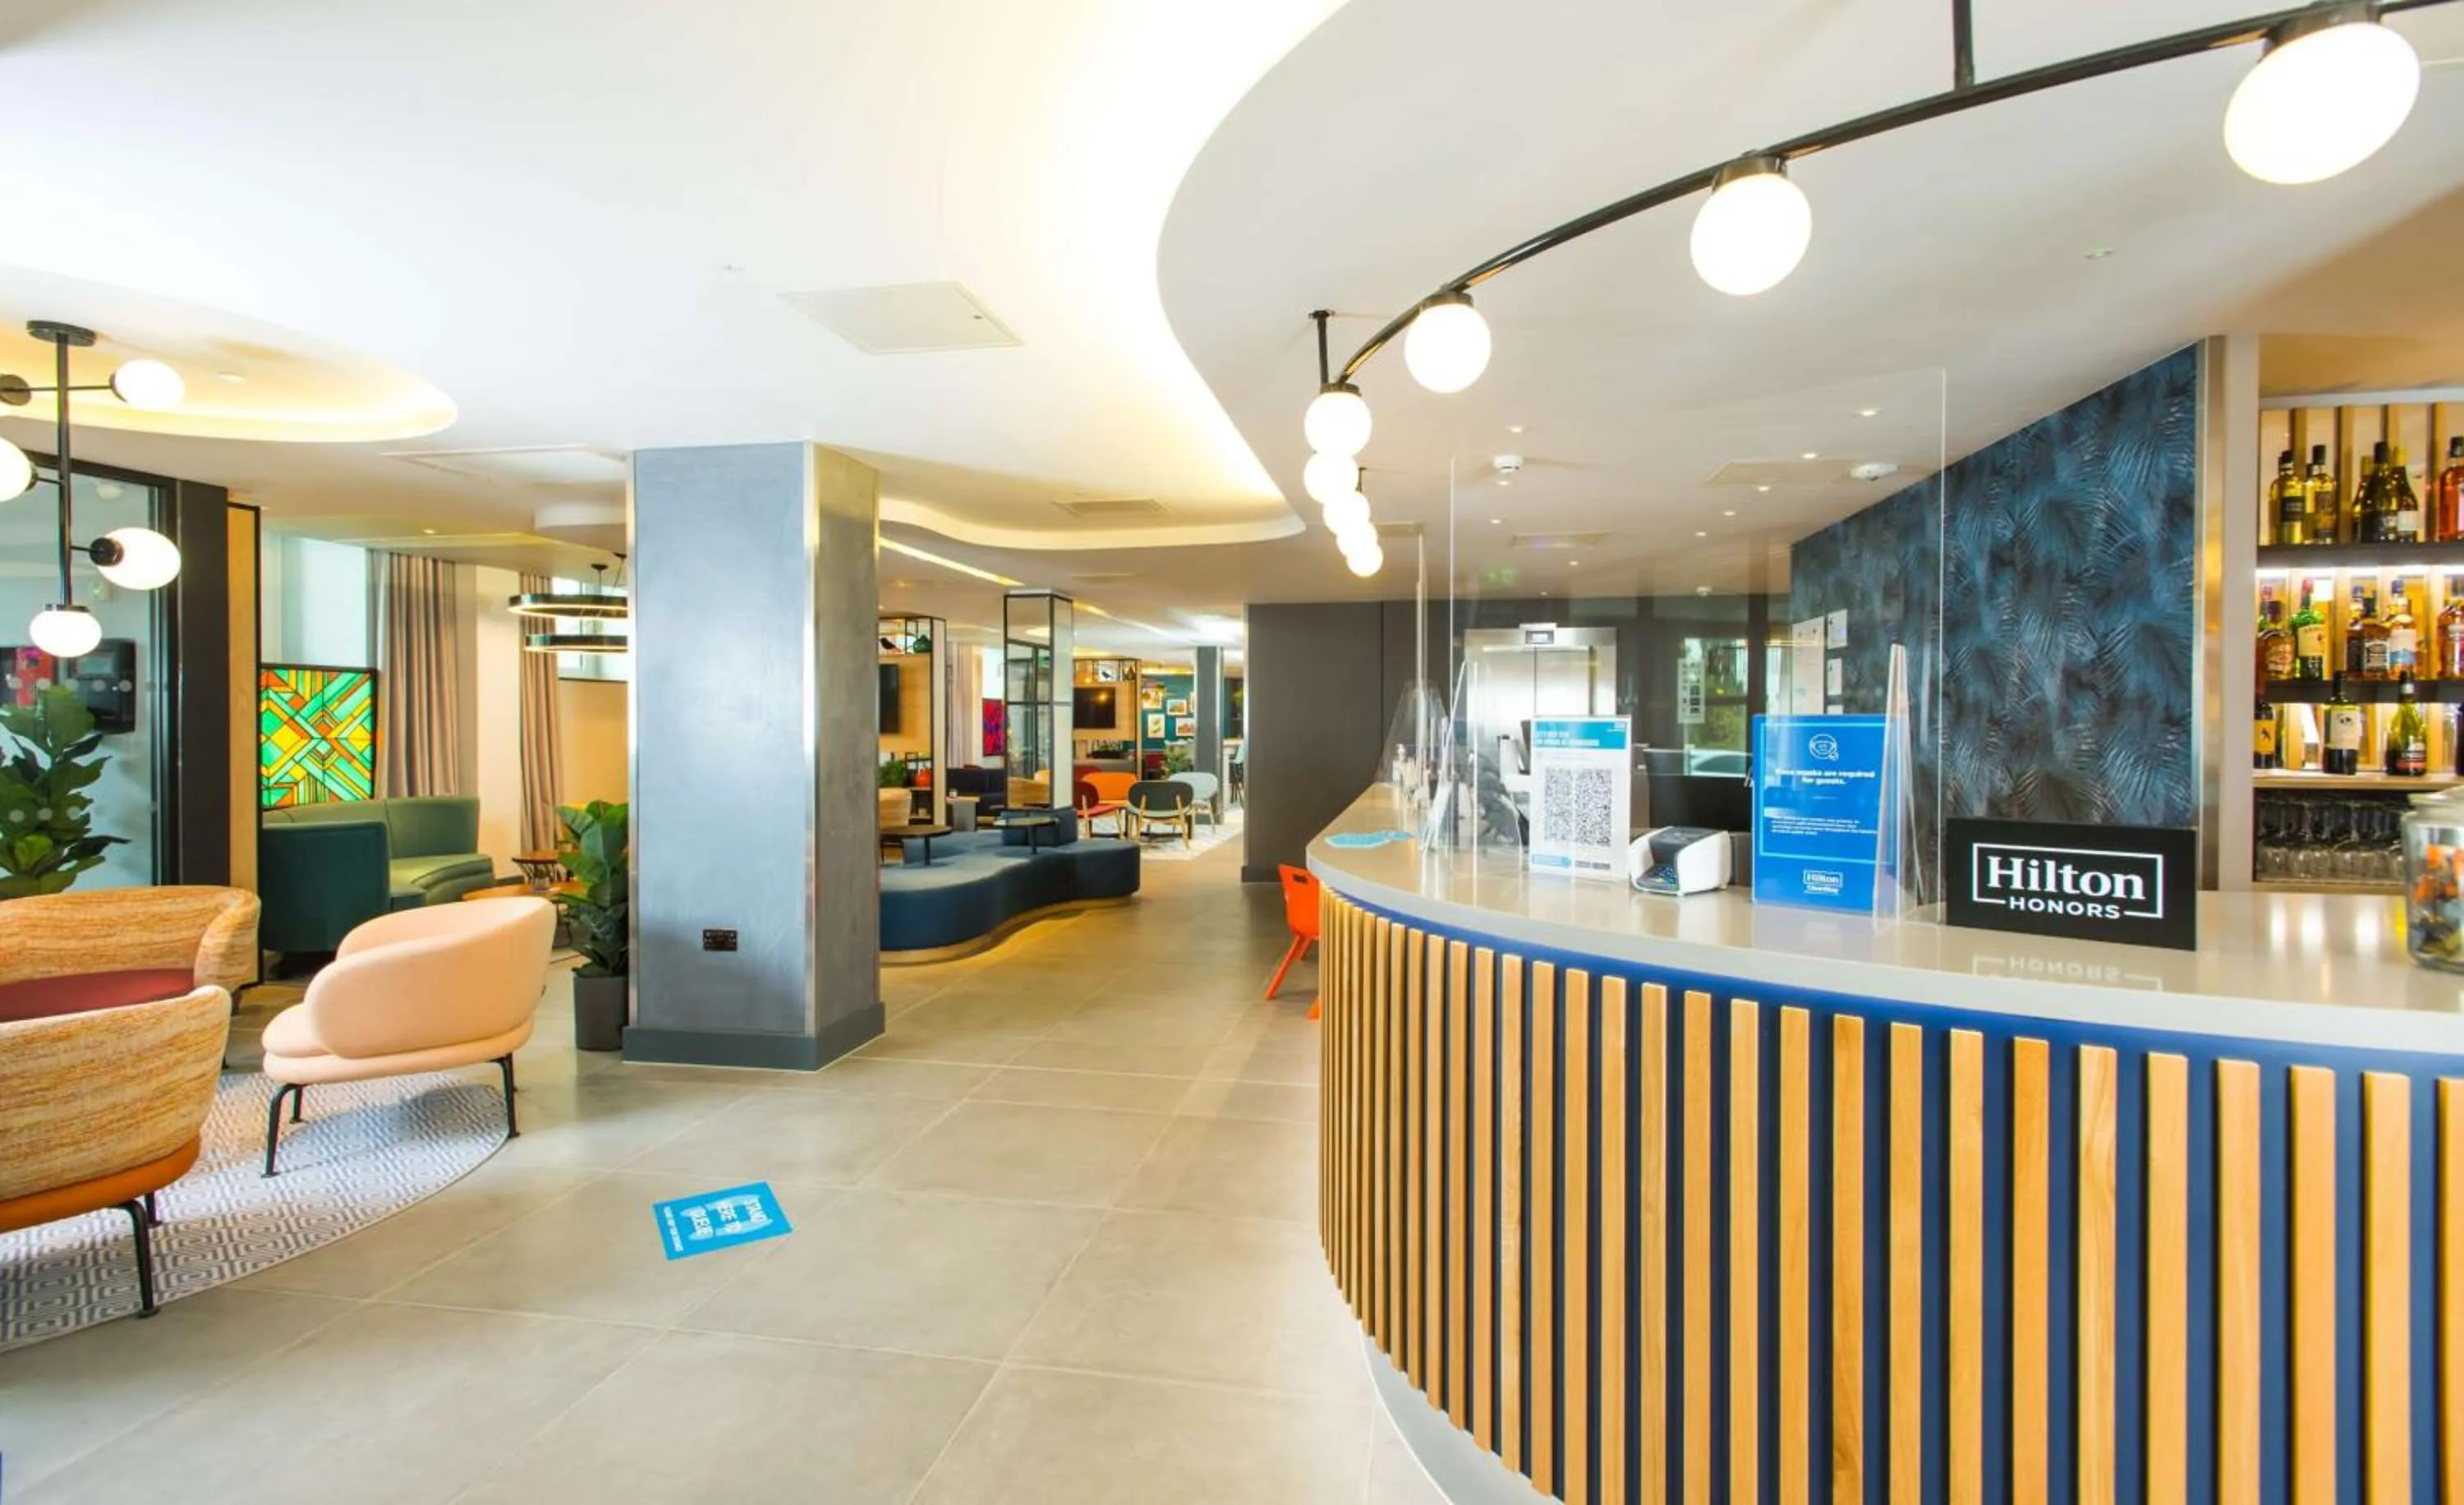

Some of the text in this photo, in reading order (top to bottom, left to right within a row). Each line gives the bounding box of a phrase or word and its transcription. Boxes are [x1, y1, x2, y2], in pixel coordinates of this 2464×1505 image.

[1839, 770, 1875, 779] required
[1807, 873, 1839, 883] Hilton
[1986, 855, 2146, 900] Hilton
[2009, 896, 2121, 919] HONORS
